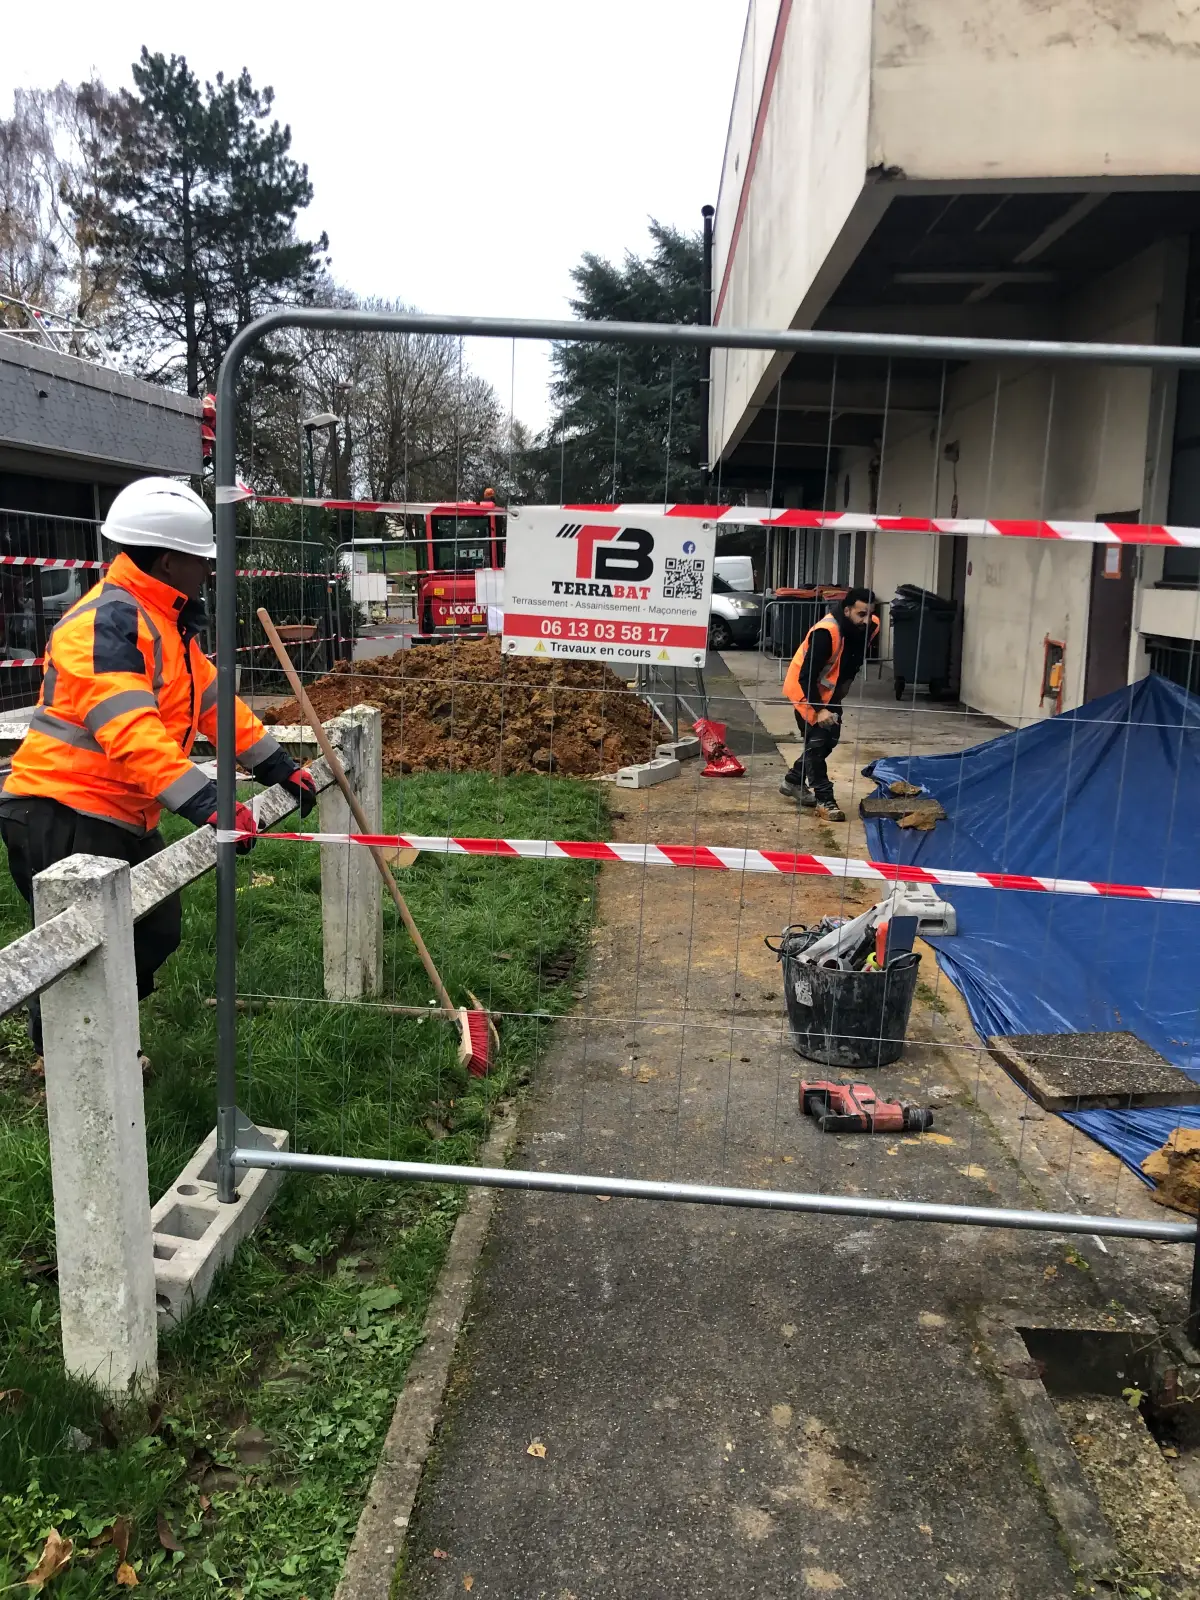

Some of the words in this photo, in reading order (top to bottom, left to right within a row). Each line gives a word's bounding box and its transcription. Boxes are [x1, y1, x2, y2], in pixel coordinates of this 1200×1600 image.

[575, 525, 654, 581] TB
[552, 581, 651, 599] TERRABAT
[512, 596, 568, 607] Terrassement
[575, 603, 640, 612] Assainissement
[649, 605, 697, 616] Maçonnerie
[541, 620, 562, 635] 06
[567, 622, 589, 637] 13
[594, 624, 615, 639] 03
[620, 626, 642, 640] 58
[648, 628, 669, 642] 17
[550, 641, 596, 654] Travaux
[600, 647, 614, 655] en
[617, 648, 651, 658] cours
